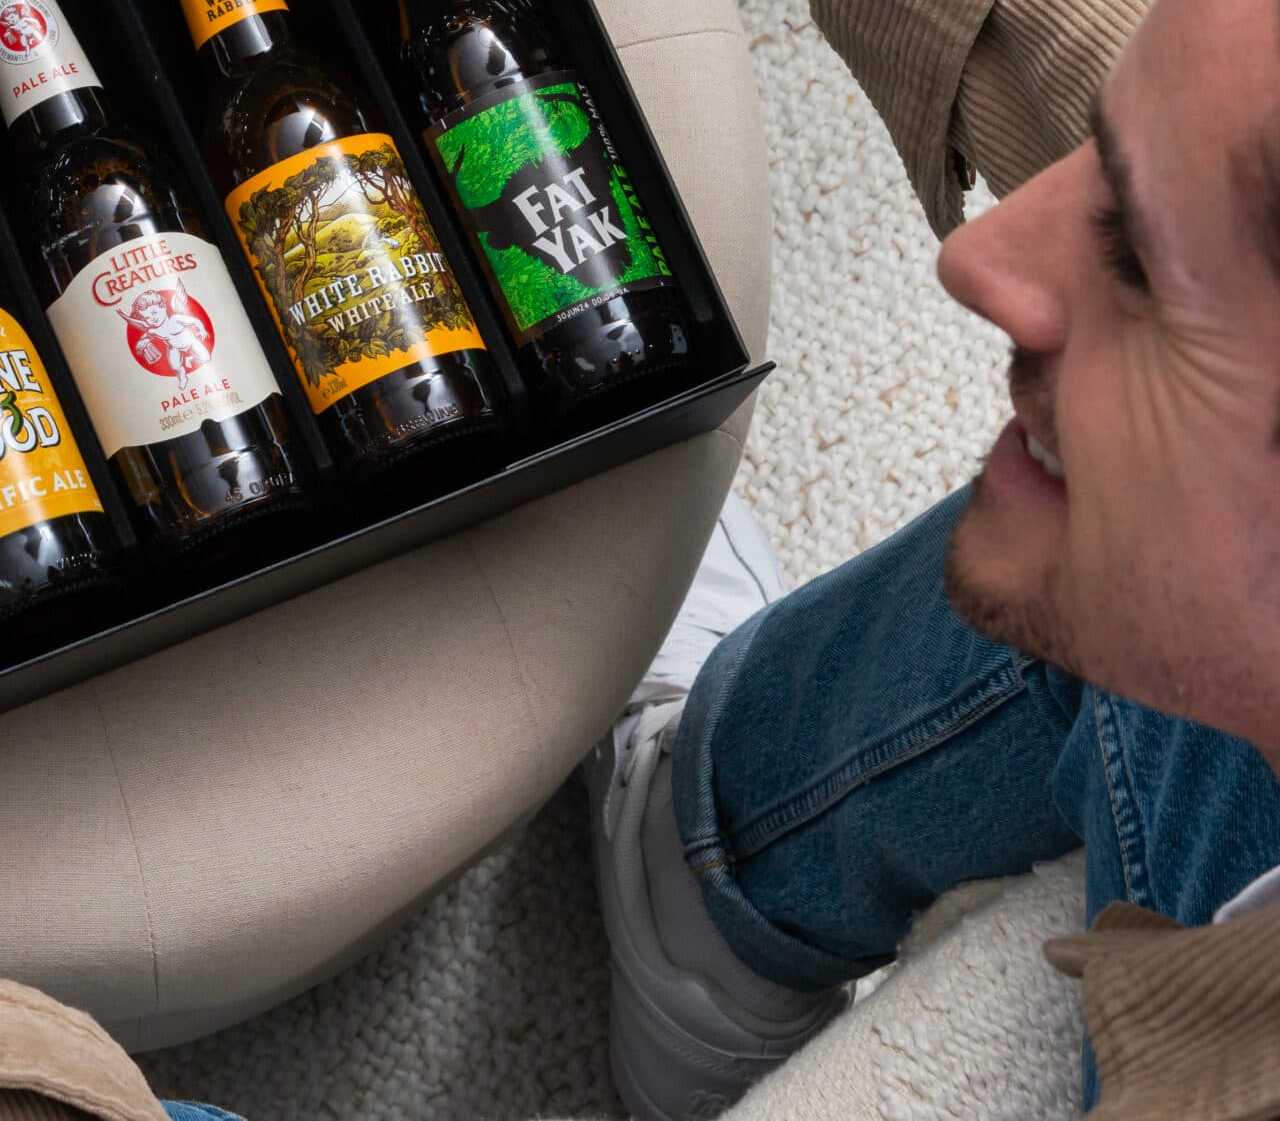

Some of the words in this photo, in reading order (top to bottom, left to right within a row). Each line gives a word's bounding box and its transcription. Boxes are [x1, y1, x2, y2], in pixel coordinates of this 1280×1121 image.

[12, 71, 48, 99] PALE
[51, 62, 80, 81] ALE
[511, 166, 598, 237] FAT
[109, 238, 173, 273] LITTLE
[531, 206, 629, 275] YAK
[91, 252, 198, 308] CREATURES
[287, 275, 364, 327] WHITE
[367, 251, 448, 291] RABBIT
[326, 291, 397, 335] WHITE
[398, 281, 436, 307] ALE
[160, 389, 201, 413] PALE
[203, 378, 232, 396] ALE
[52, 469, 88, 493] ALE
